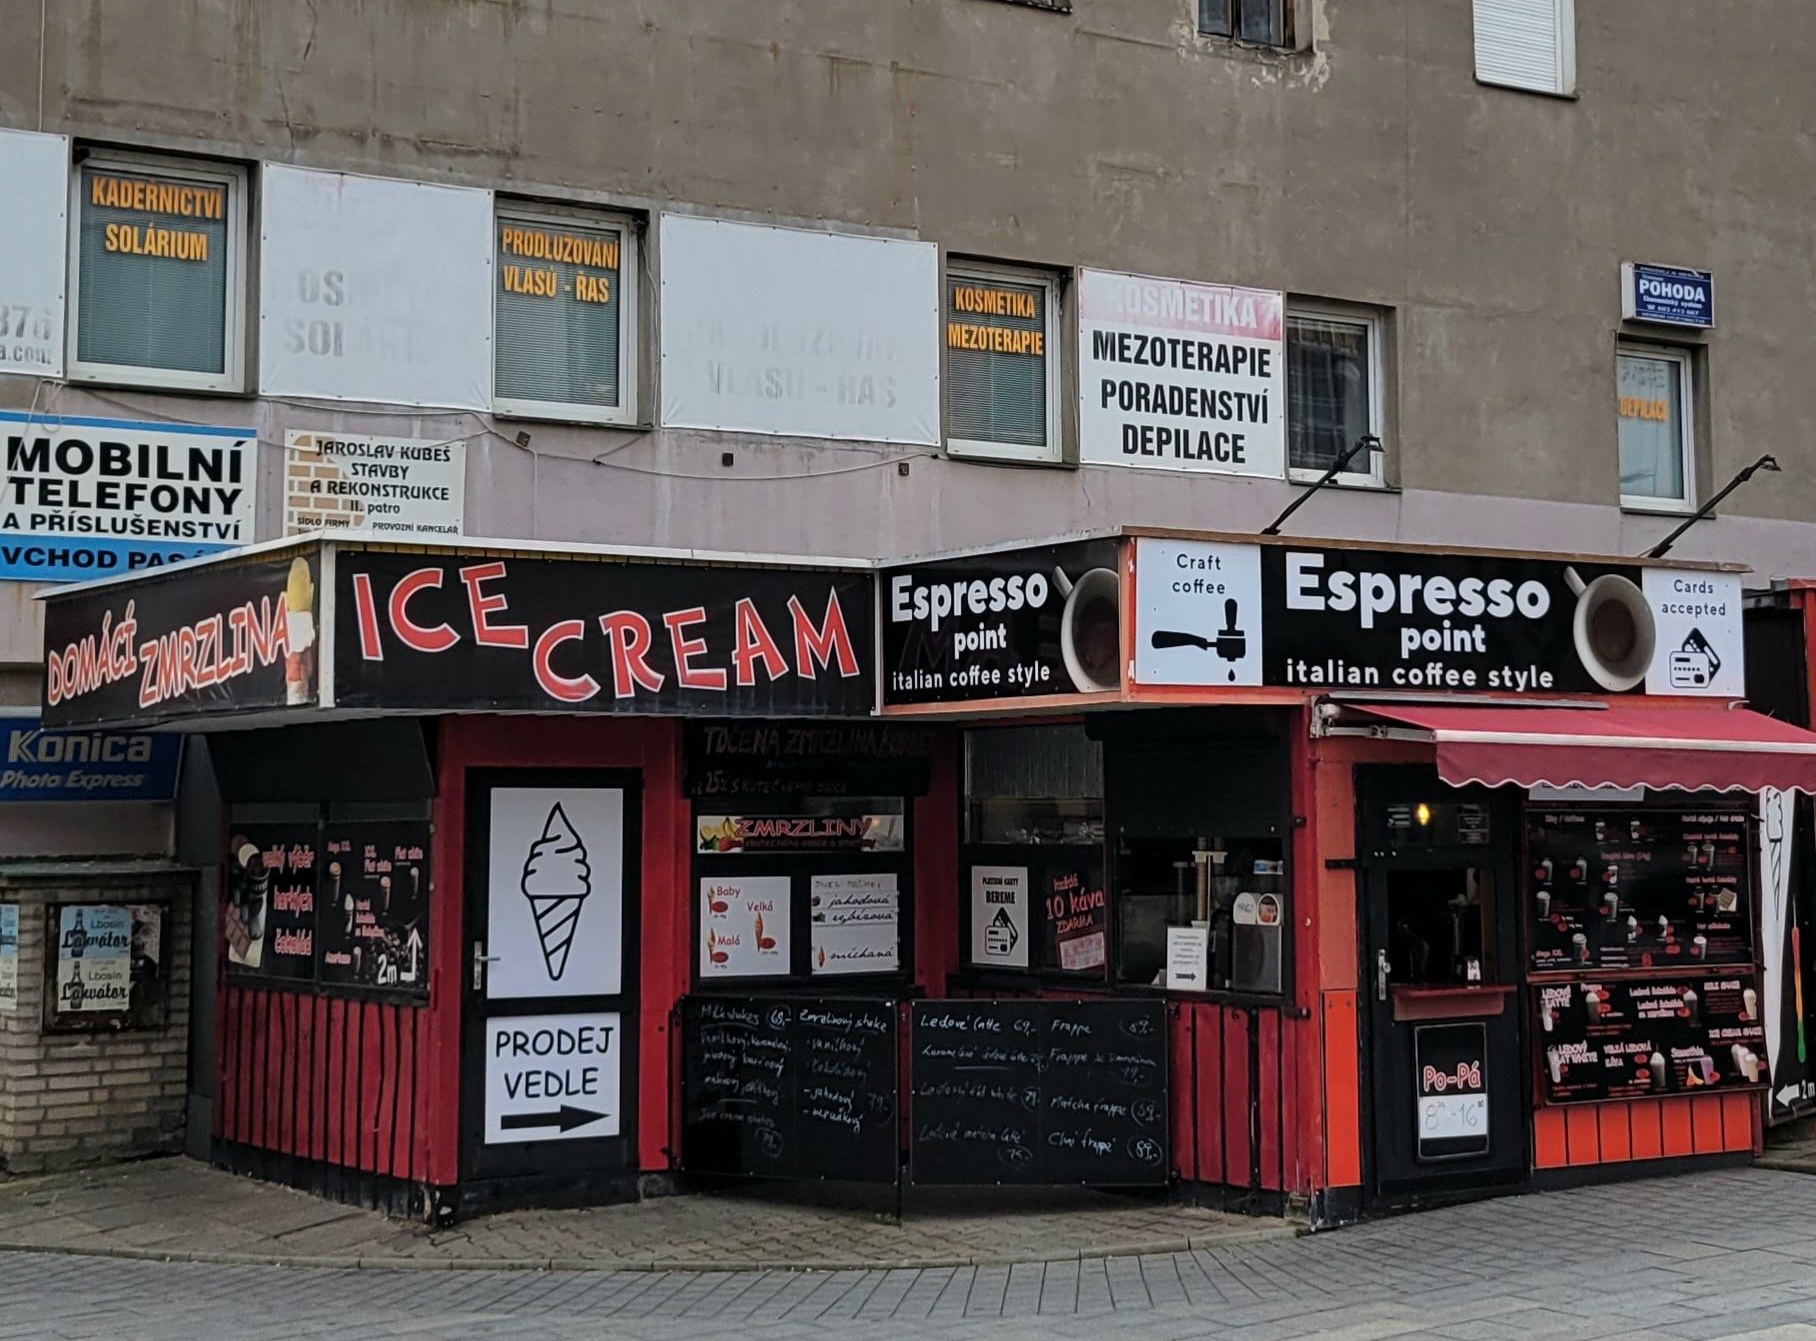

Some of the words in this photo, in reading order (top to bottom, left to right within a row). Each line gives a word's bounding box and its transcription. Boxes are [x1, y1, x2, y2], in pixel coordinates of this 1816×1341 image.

[93, 176, 222, 220] KADEŘNICTVÍ
[105, 223, 208, 261] SOLÁRIUM
[502, 227, 619, 270] PRODLUŽOVÁNÍ
[504, 265, 557, 298] VLASŮ
[1639, 279, 1705, 302] POHODA
[955, 287, 1036, 319] KOSMETIKA
[948, 324, 1044, 356] MEZOTERAPIE
[1093, 330, 1271, 378] MEZOTERAPIE
[1101, 379, 1268, 424] PORADENSTVÍ
[316, 440, 395, 458] JAROSLAV
[401, 446, 451, 462] KUBEŠ
[1122, 423, 1246, 464] DEPILACE
[7, 436, 248, 484] MOBILNÍ
[351, 463, 410, 480] STAVBY
[7, 476, 244, 516] TELEFONY
[310, 480, 321, 494] A
[327, 480, 450, 500] REKONSTRUKCE
[2, 512, 20, 530] A
[30, 509, 243, 540] PŘÍSLUŠENSTVÍ
[325, 518, 350, 529] FIRMY
[368, 503, 400, 516] patro
[373, 521, 414, 531] PROVOZNÍ
[1, 546, 118, 570] VCHOD
[1176, 554, 1221, 571] Craft
[891, 572, 1048, 632] Espresso
[1172, 578, 1226, 595] coffee
[1285, 551, 1551, 628] Espresso
[1673, 578, 1715, 595] Cards
[352, 561, 529, 661] ICE
[1661, 601, 1727, 618] accepted
[48, 599, 138, 706] DOMÁCÍ
[139, 591, 291, 708] ZMRZLINA
[532, 585, 860, 703] CREAM
[954, 622, 1007, 659] point
[1401, 619, 1486, 658] point
[892, 668, 943, 691] italian
[949, 664, 1001, 687] coffee
[1008, 661, 1050, 686] style
[1286, 658, 1380, 685] italian
[1392, 661, 1476, 687] coffee
[1488, 663, 1554, 692] style
[8, 730, 152, 763] Konica
[0, 770, 61, 789] Photo
[65, 769, 145, 790] Express
[735, 817, 873, 837] ZMRZLINY
[717, 886, 741, 899] Baby
[747, 900, 773, 912] Velká
[986, 890, 1015, 904] BEREME
[1045, 894, 1064, 920] 10
[1069, 886, 1104, 914] káva
[1056, 913, 1094, 934] ZDARMA
[717, 934, 740, 946] Malá
[496, 1026, 614, 1057] PRODEJ
[504, 1067, 599, 1100] VEDLE
[1423, 1060, 1481, 1092] Po-Pá
